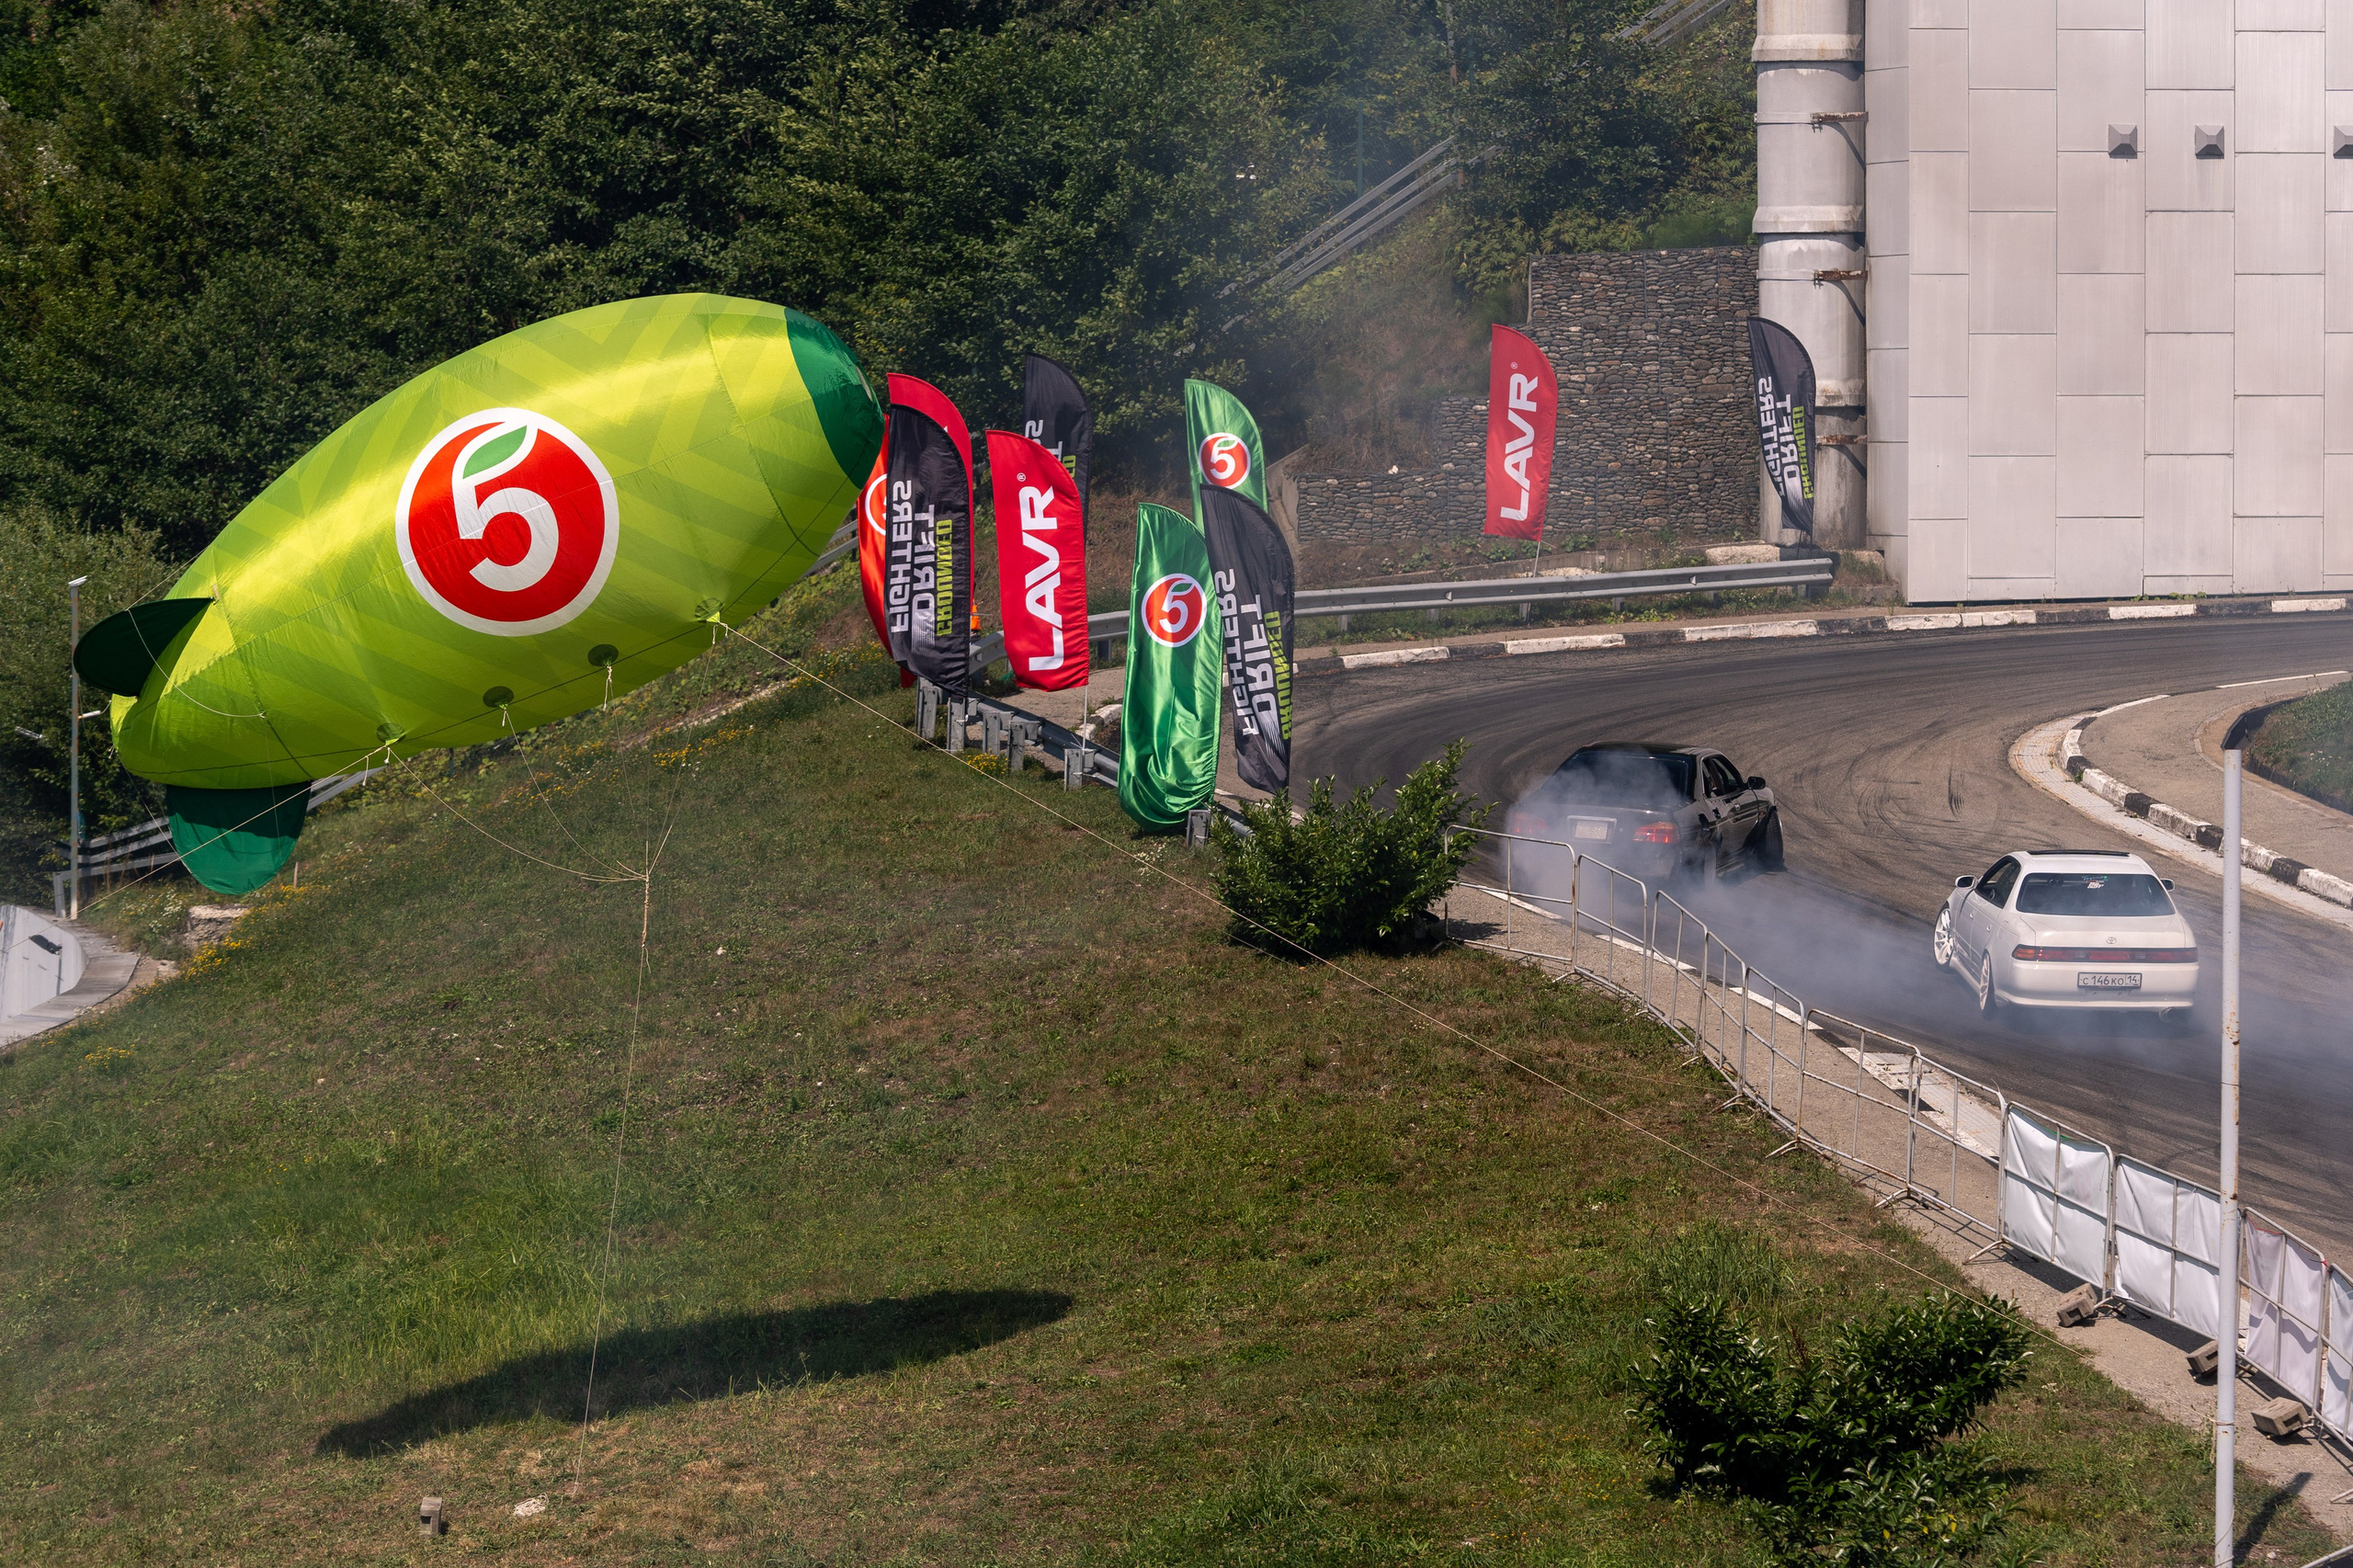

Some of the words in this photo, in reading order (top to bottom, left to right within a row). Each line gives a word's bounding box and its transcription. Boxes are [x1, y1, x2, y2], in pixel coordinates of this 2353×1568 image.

[1210, 436, 1239, 480] 5
[452, 425, 559, 592] 5
[1159, 580, 1195, 633] 5
